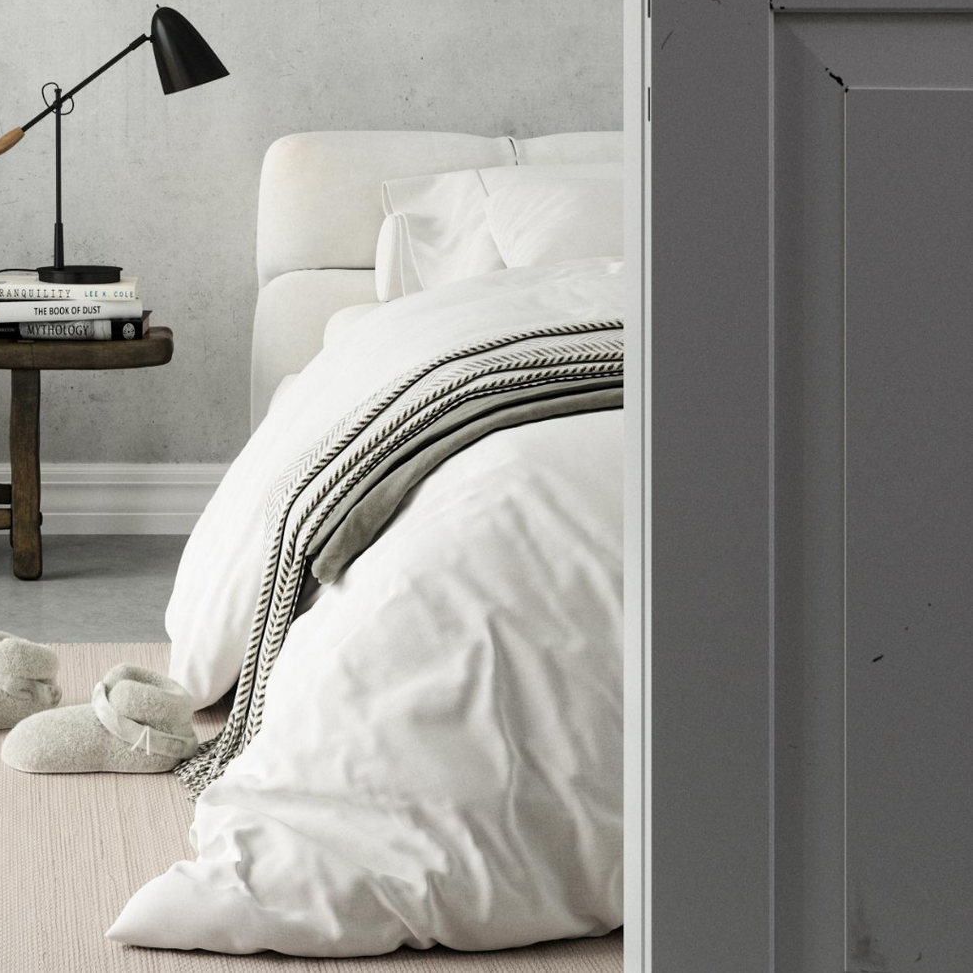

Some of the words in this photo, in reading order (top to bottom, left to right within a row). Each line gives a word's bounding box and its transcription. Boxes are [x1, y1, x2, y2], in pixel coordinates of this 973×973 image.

[34, 307, 47, 315] THE
[49, 307, 69, 315] BOOK
[71, 306, 81, 314] OF
[82, 306, 101, 314] DUST
[27, 324, 89, 336] MYTHOLOGY
